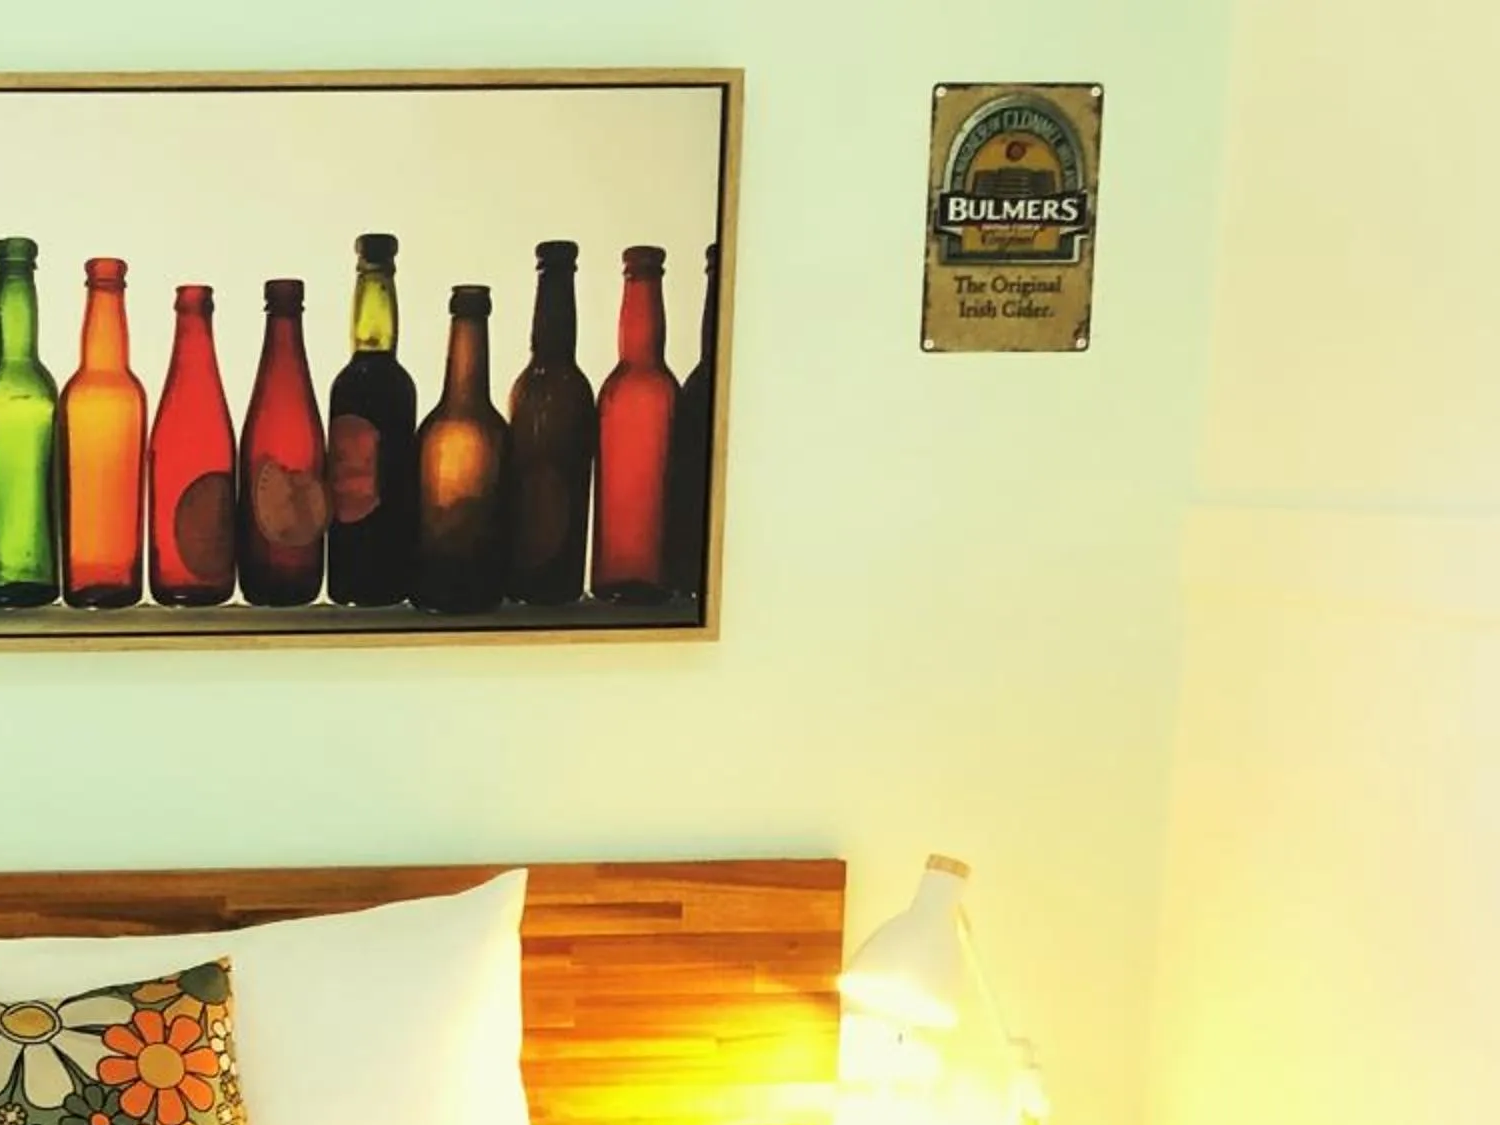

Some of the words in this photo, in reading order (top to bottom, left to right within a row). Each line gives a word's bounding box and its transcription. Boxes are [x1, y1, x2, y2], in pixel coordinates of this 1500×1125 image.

[948, 196, 1079, 222] BULMERS
[953, 275, 986, 294] The
[991, 275, 1062, 298] Original
[959, 300, 996, 319] Irish
